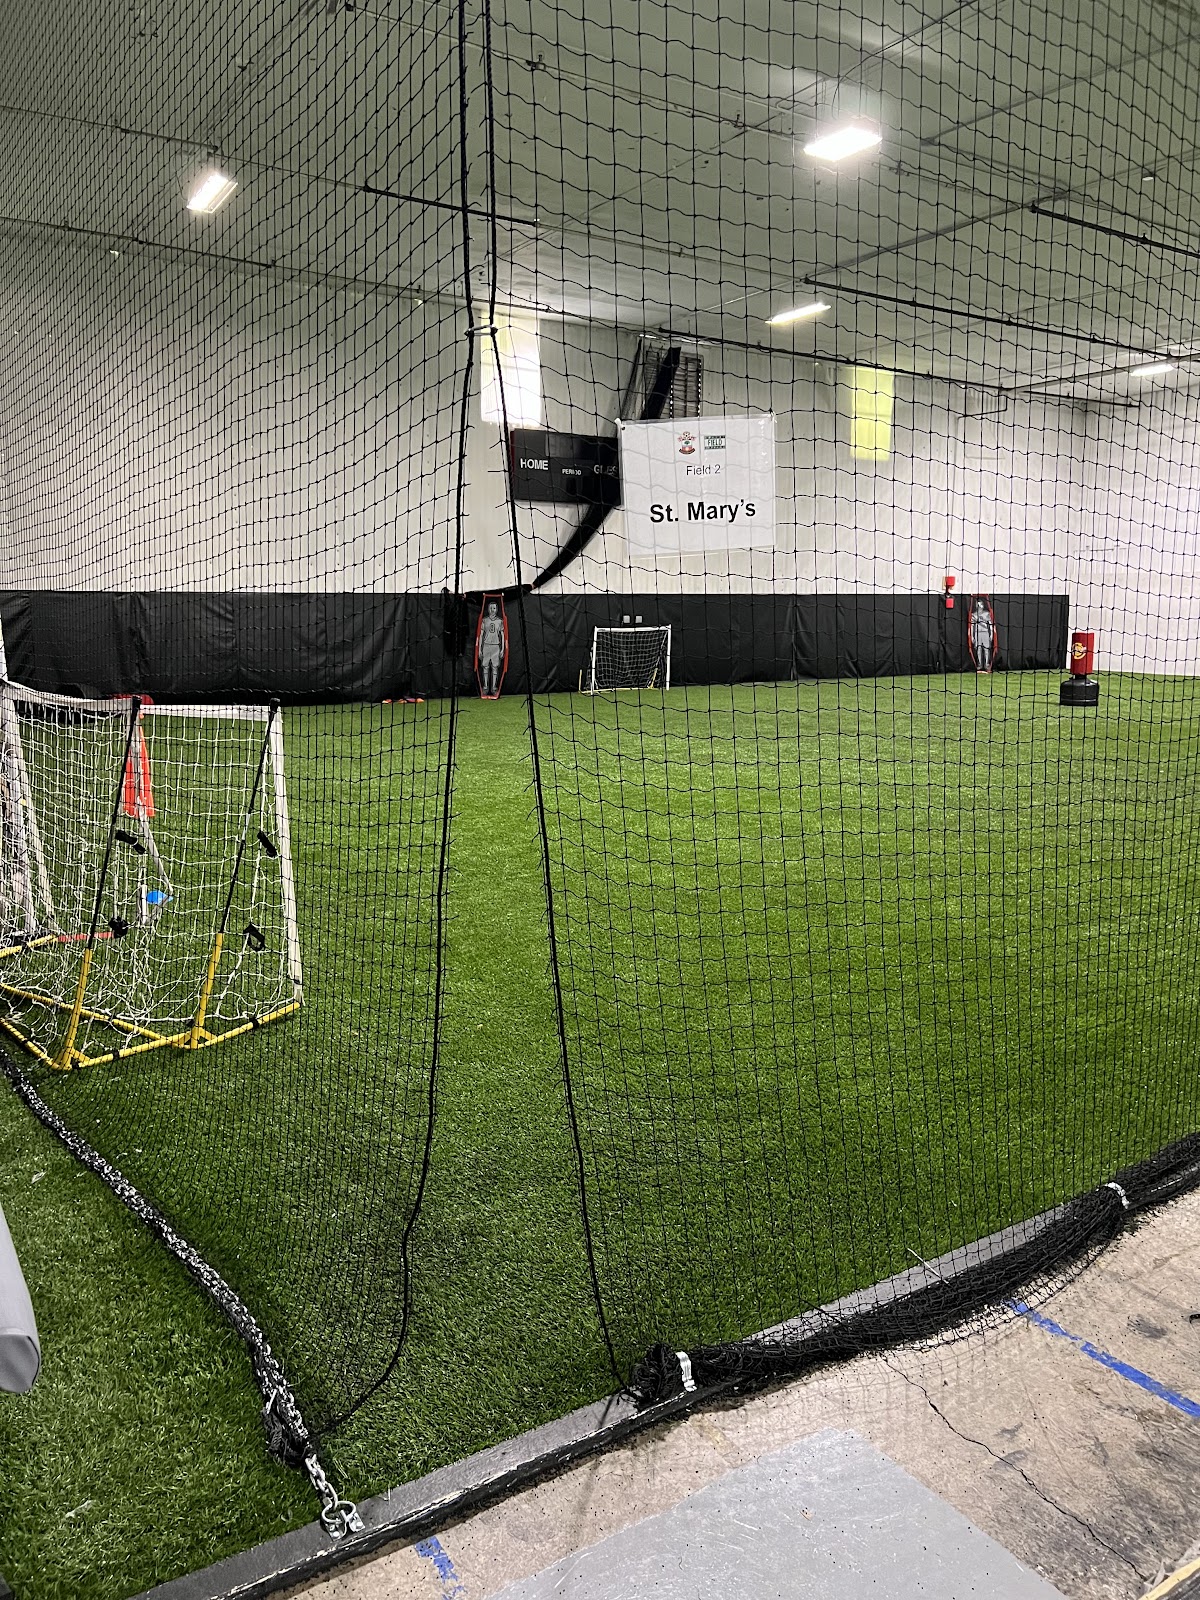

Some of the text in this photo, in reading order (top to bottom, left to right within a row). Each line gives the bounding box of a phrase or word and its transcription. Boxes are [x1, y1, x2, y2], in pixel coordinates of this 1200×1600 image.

[520, 458, 549, 471] HOME
[593, 464, 618, 475] GES
[686, 463, 721, 476] Field 2
[650, 498, 756, 523] St. Mary’s
